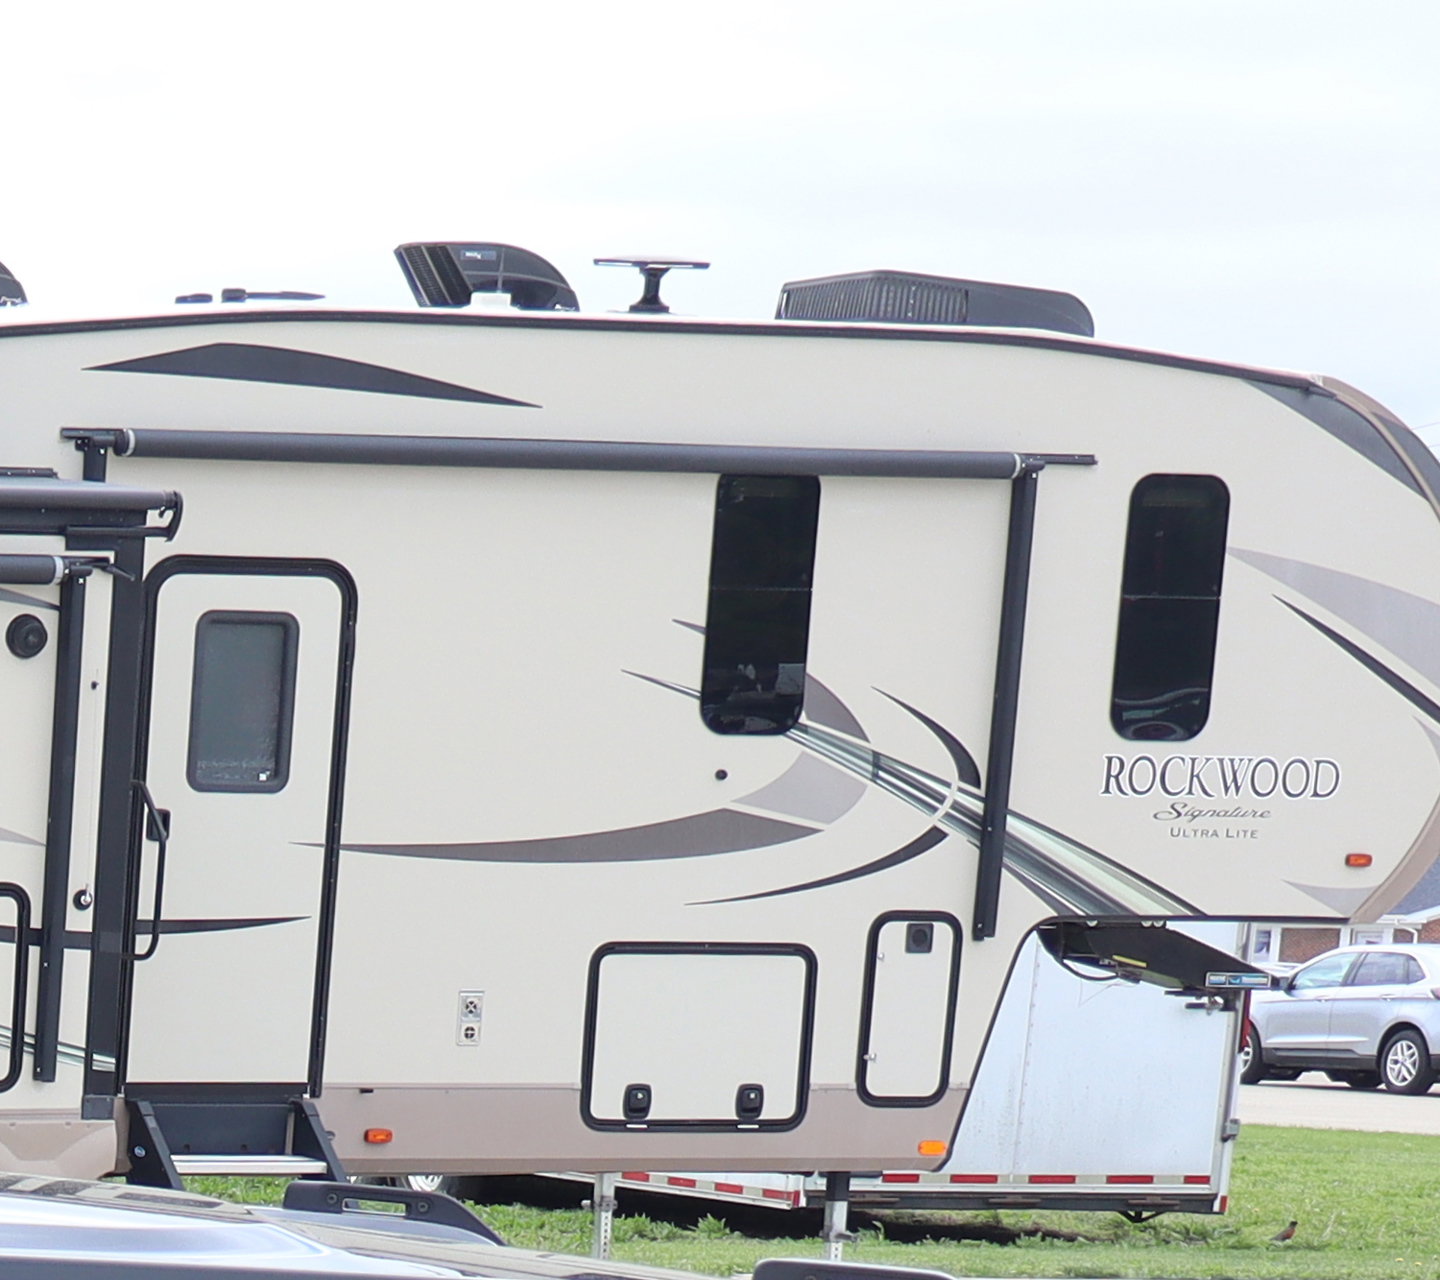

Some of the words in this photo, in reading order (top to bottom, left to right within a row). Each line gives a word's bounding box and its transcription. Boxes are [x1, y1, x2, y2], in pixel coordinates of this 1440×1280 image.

[1101, 755, 1341, 798] ROCKWOOD
[1153, 802, 1272, 823] Signature
[1170, 827, 1220, 839] ULTRA
[1225, 828, 1258, 839] LITE
